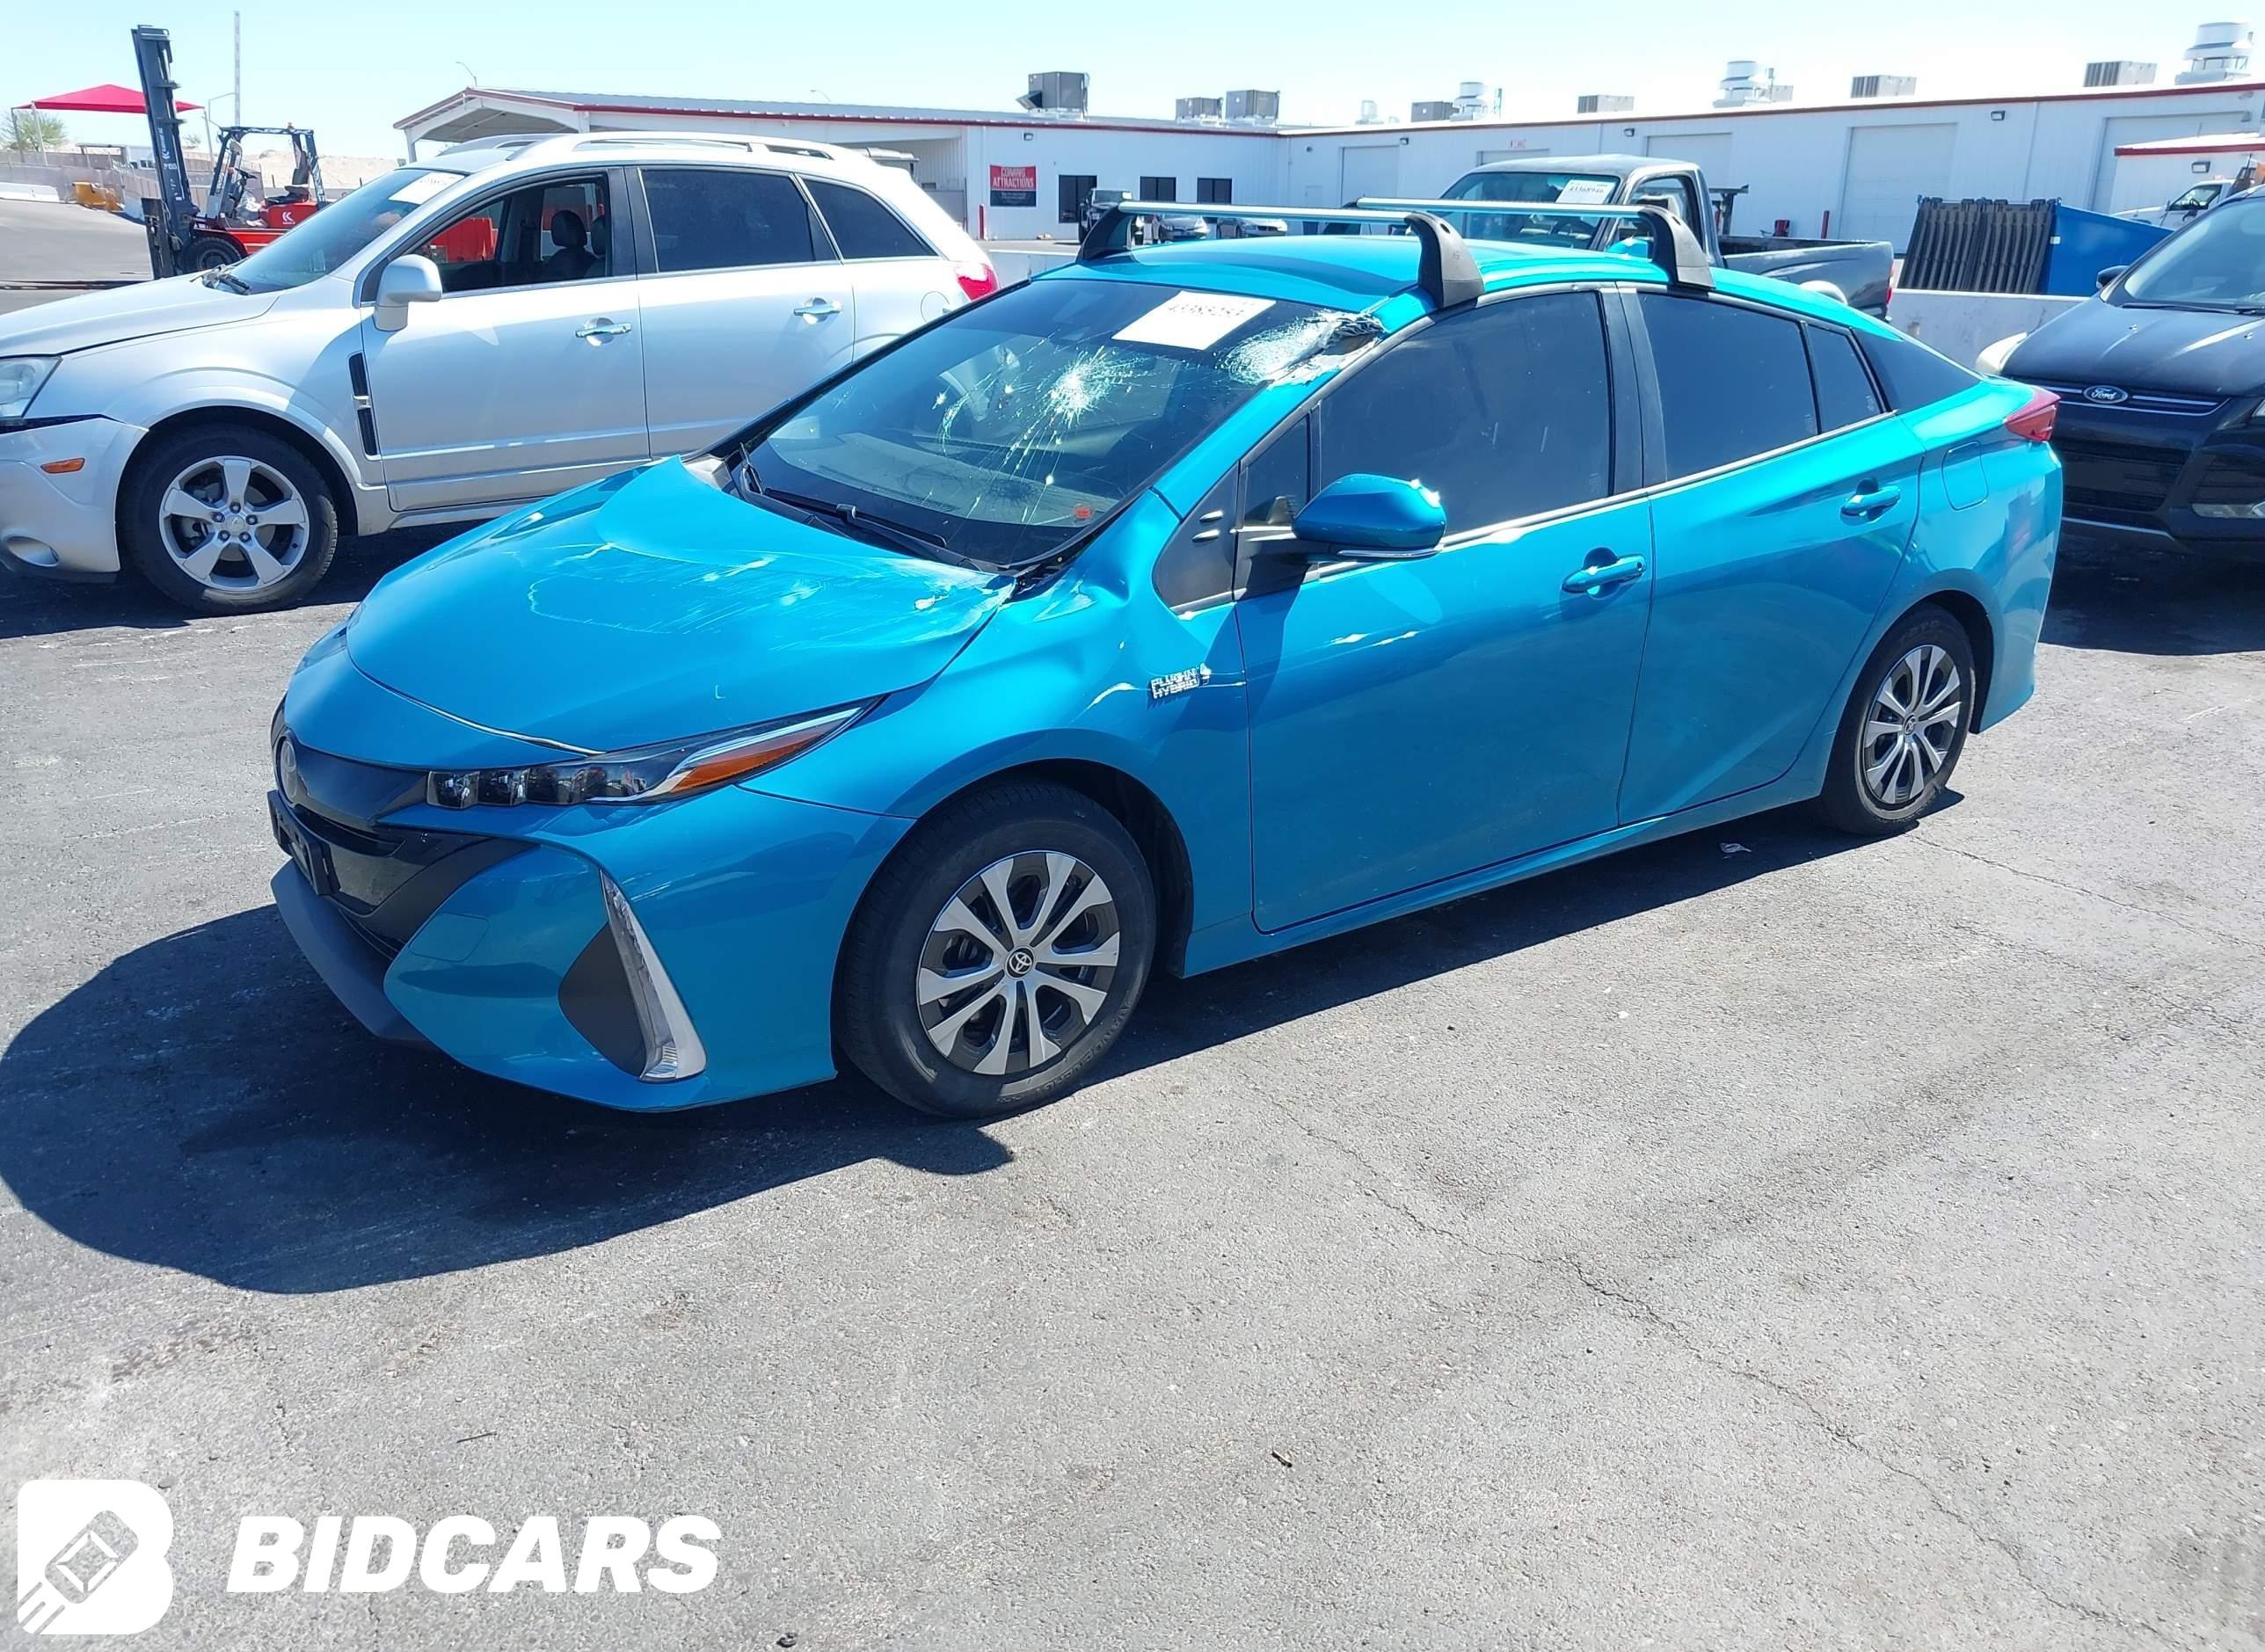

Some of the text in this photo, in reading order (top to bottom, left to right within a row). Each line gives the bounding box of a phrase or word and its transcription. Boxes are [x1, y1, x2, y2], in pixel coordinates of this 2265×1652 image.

[1001, 168, 1026, 178] COMING
[993, 178, 1035, 188] ATTRACTIONS
[2092, 387, 2117, 400] Ford
[1152, 678, 1199, 700] HYBRID
